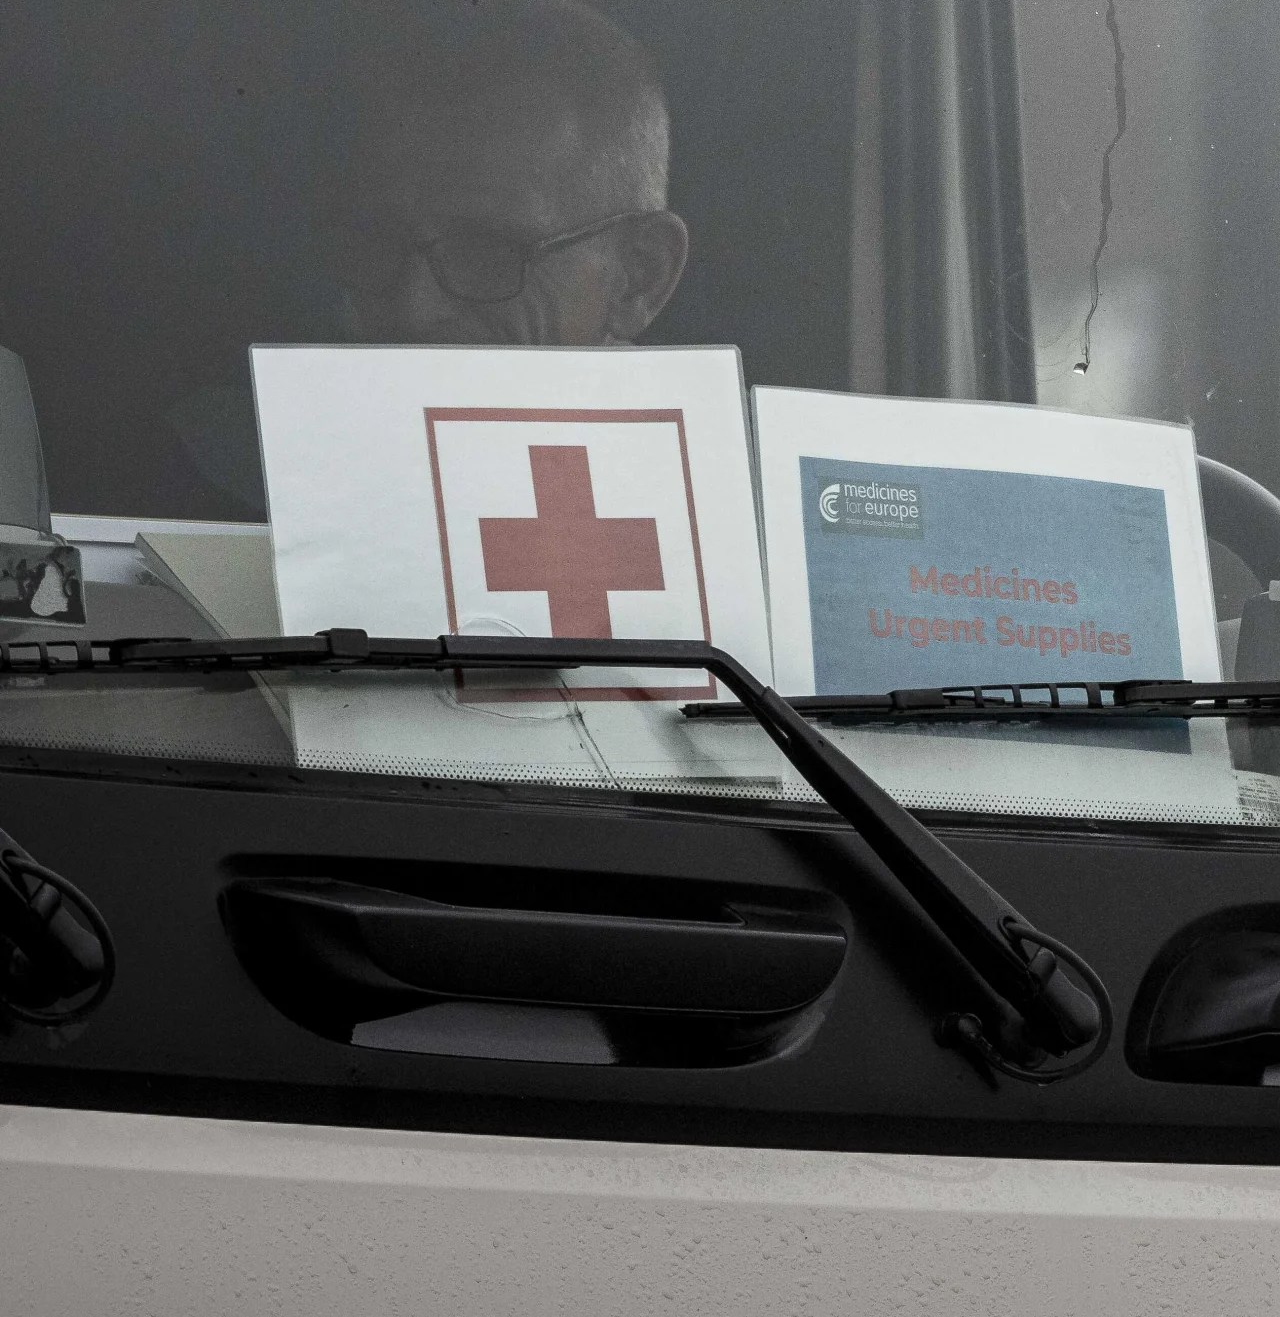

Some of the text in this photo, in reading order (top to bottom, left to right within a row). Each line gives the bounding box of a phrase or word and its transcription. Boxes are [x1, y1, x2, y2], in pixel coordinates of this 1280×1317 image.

[844, 482, 917, 502] medicines
[846, 498, 919, 521] for europe
[909, 564, 1078, 605] Medicines
[868, 608, 1132, 659] Urgent Supplies
